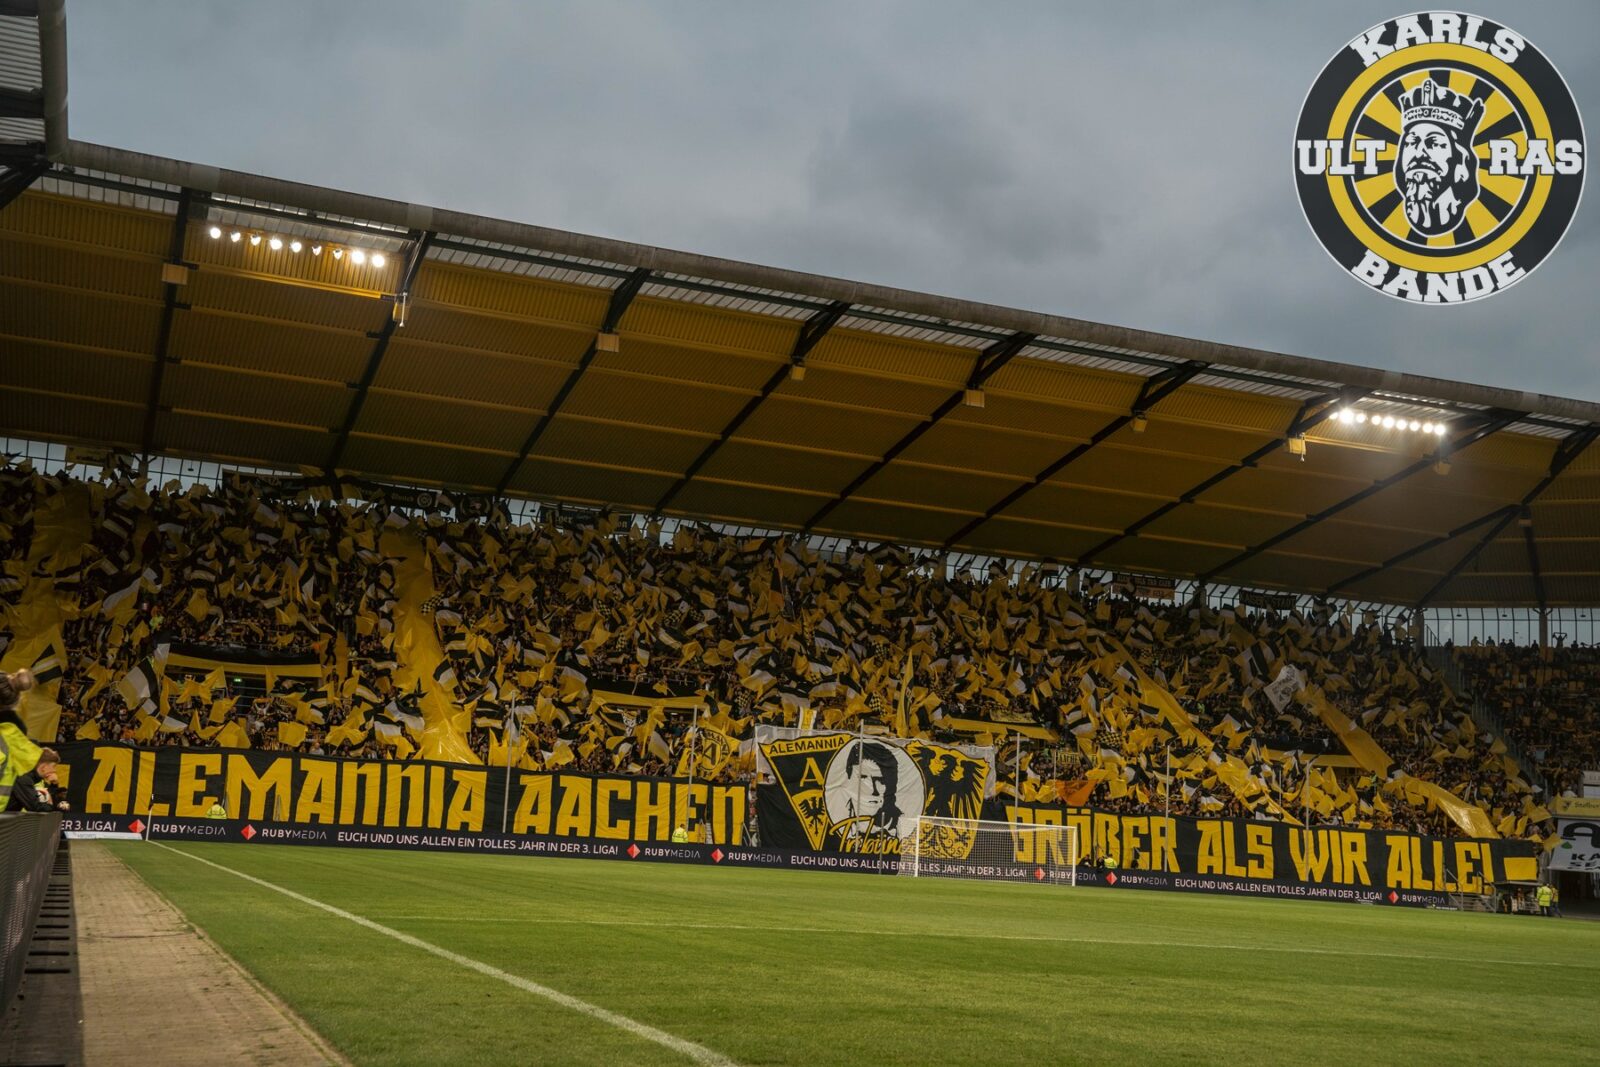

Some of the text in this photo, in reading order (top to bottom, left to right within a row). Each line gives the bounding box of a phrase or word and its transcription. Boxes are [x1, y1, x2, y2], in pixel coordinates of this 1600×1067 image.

[769, 736, 845, 755] ALEMANNIA
[800, 756, 825, 787] A
[85, 746, 487, 832] ALEMANNIA
[512, 774, 746, 846] AACHEN
[75, 820, 84, 831] 3.
[86, 820, 117, 832] LIGA!
[152, 823, 226, 835] RUBYMEDIA
[261, 828, 327, 840] RUBYMEDIA
[337, 831, 618, 856] EUCH UND UNS ALLEN EIN TOLLES JAHR IN DER 3. LIGA!
[644, 847, 701, 859] RUBYMEDIA
[728, 852, 783, 863] RUBYMEDIA
[790, 855, 816, 865] EUCH
[817, 857, 838, 867] UND
[840, 858, 859, 868] UNS
[860, 859, 890, 870] ALLEN
[890, 861, 905, 871] EIN
[977, 867, 994, 876] DER
[996, 868, 1004, 877] 3.
[1005, 868, 1027, 878] LIGA!
[1196, 820, 1274, 880] ALS
[1288, 828, 1372, 886] WIR
[1385, 835, 1495, 895] ALLE!
[1121, 875, 1168, 886] RUBYMEDIA
[1175, 878, 1383, 901] EUCH UND UNS ALLEN EIN TOLLES JAHR IN DER 3. LIGA!
[1401, 894, 1446, 904] RUBYMEDIA
